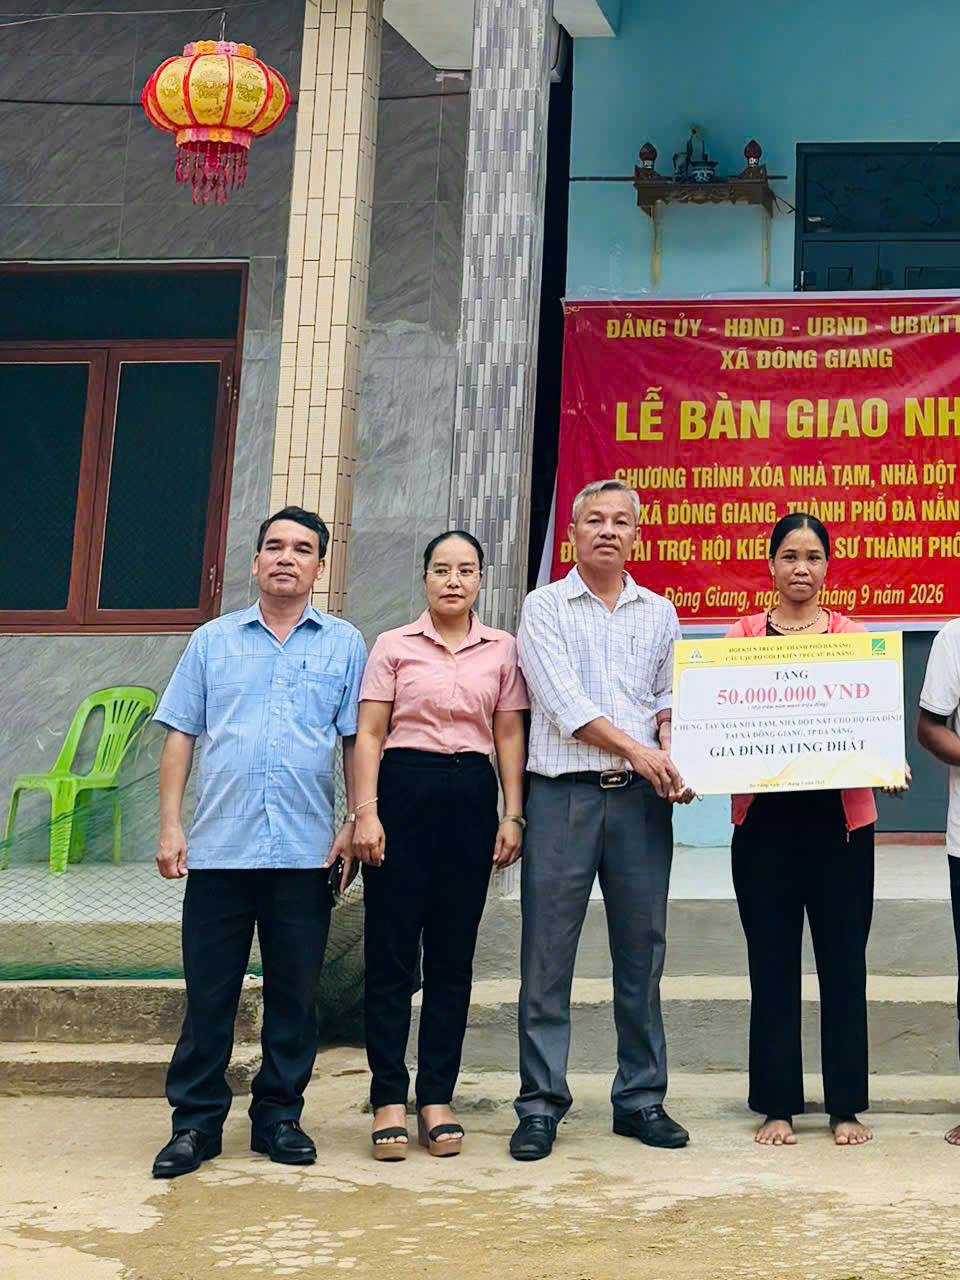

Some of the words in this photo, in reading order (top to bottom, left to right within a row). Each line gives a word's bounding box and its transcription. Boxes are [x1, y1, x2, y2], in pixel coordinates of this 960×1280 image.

[606, 312, 667, 339] ĐẢNG
[673, 312, 703, 337] ỦY
[724, 318, 785, 337] HĐND
[807, 316, 868, 337] UBND
[720, 346, 750, 370] XÃ
[756, 346, 818, 369] ĐÔNG
[824, 348, 893, 368] GIANG
[615, 386, 665, 441] LỄ
[679, 392, 772, 440] BÀN
[786, 397, 889, 439] GIAO
[614, 466, 687, 489] CHƯƠNG
[691, 462, 744, 488] TRÌNH
[749, 462, 785, 487] XÓA
[790, 460, 827, 486] NHÀ
[831, 464, 876, 491] TẠM,
[880, 459, 918, 485] NHÀ
[923, 459, 957, 491] DỘT
[638, 499, 663, 526] XÃ
[668, 498, 717, 526] ĐÔNG
[852, 492, 888, 522] PHỐ
[892, 495, 916, 522] ĐÀ
[657, 537, 697, 566] TRỢ:
[701, 534, 731, 566] HỘI
[834, 535, 860, 559] SƯ
[864, 532, 923, 559] THÀNH
[705, 587, 751, 612] Giang,
[816, 583, 857, 611] tháng
[861, 584, 870, 605] 9
[873, 583, 905, 605] năm
[908, 583, 945, 604] 2026
[717, 684, 816, 705] 50.000.000
[822, 683, 870, 700] VNĐ
[709, 745, 736, 758] GIA
